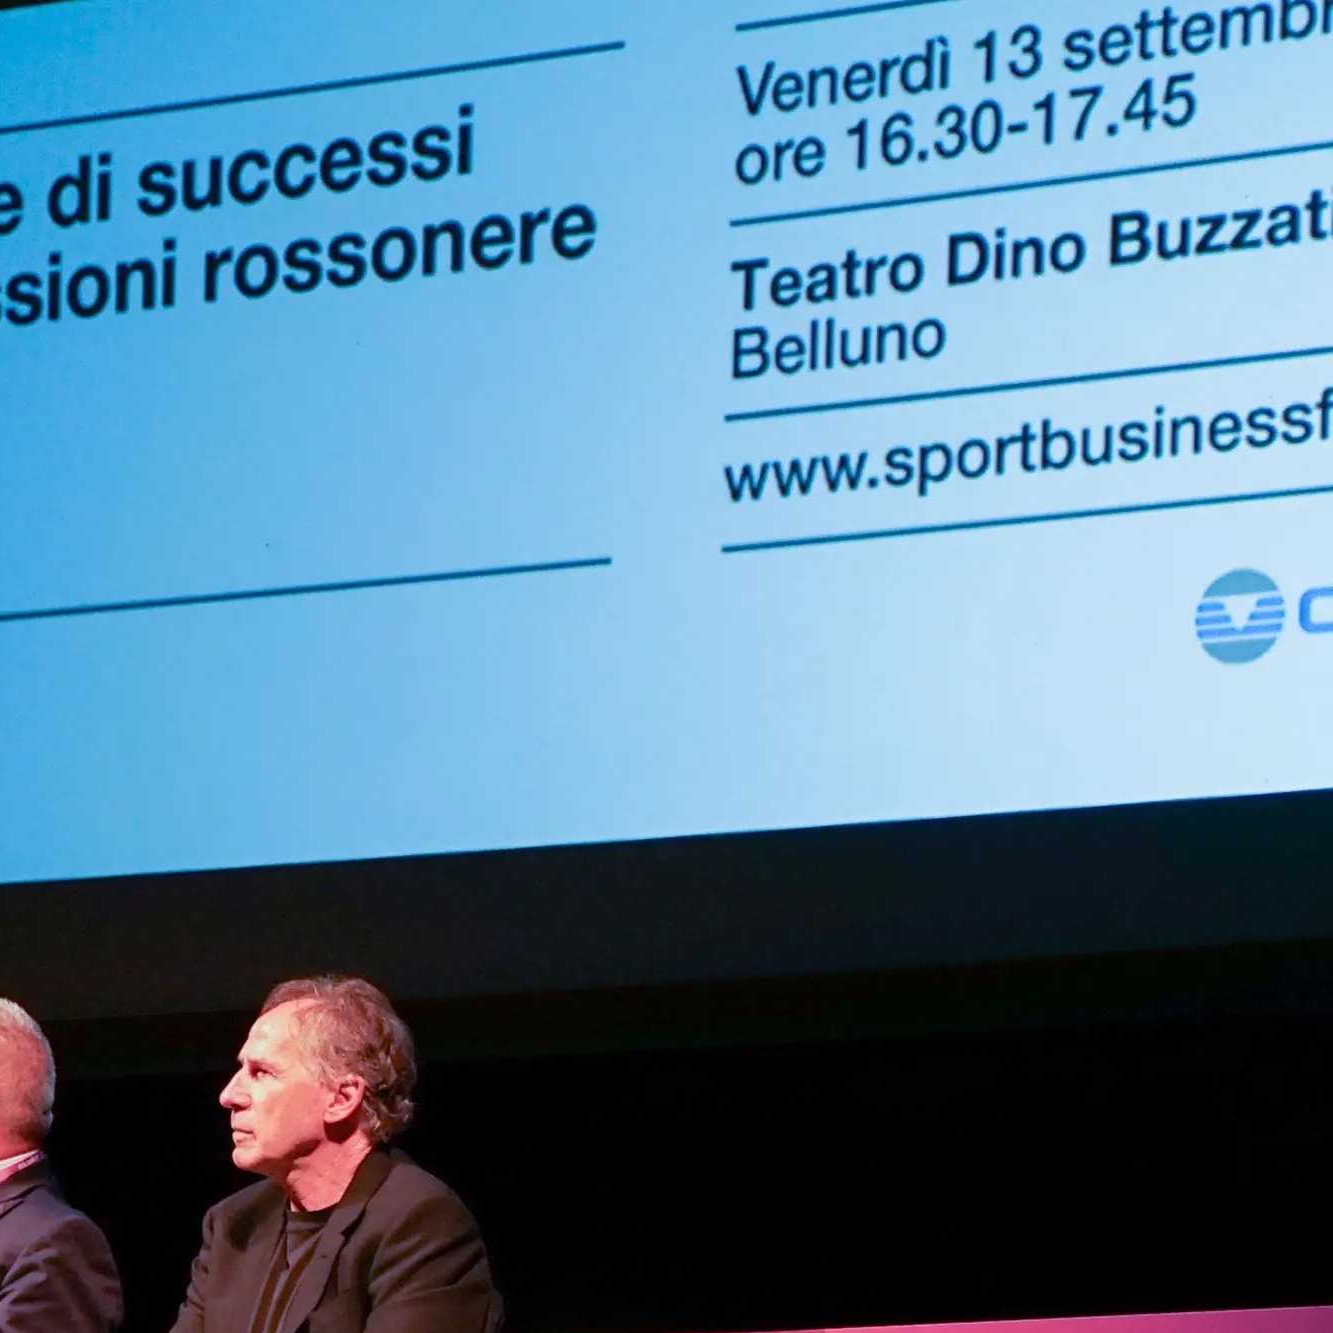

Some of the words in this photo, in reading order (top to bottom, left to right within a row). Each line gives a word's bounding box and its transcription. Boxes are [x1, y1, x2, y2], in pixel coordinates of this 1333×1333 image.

[736, 35, 950, 117] Venerdì
[973, 24, 1043, 84] 13
[47, 152, 113, 228] di
[137, 104, 474, 217] successi
[735, 134, 826, 186] ore
[846, 72, 1197, 170] 16.30-17.45
[203, 203, 598, 303] rossonere
[730, 247, 924, 312] Teatro
[947, 226, 1087, 287] Dino
[1109, 188, 1333, 267] Buzzat
[731, 316, 947, 379] Belluno
